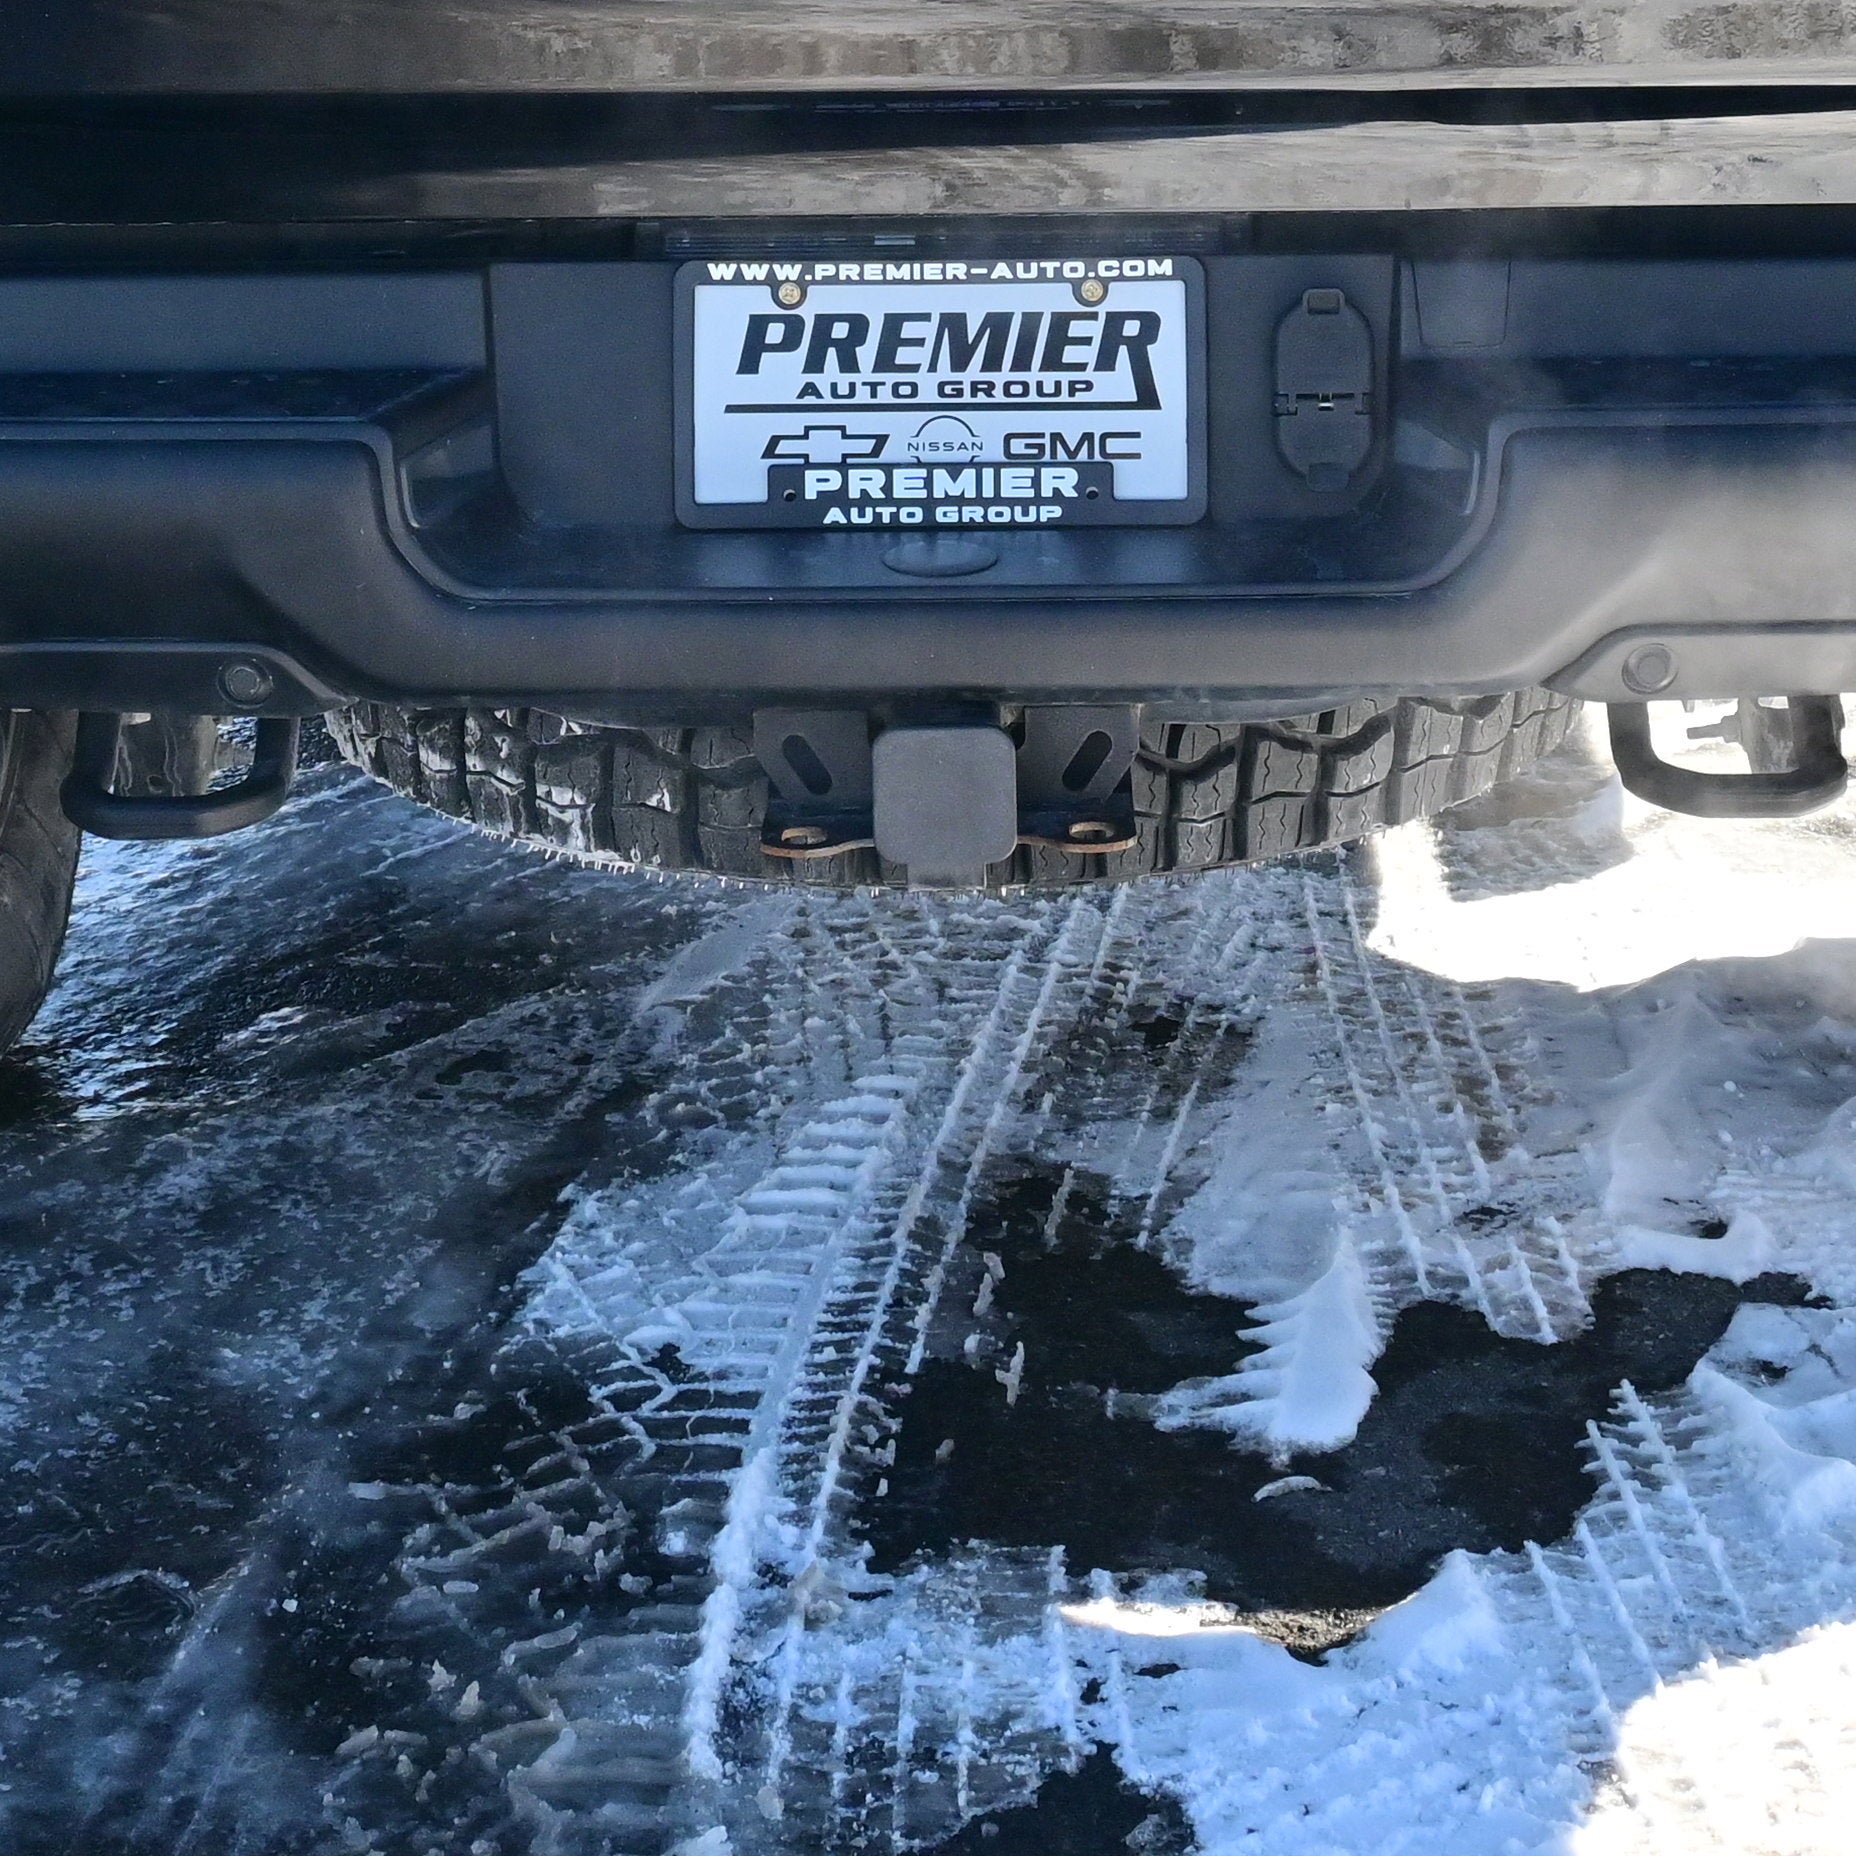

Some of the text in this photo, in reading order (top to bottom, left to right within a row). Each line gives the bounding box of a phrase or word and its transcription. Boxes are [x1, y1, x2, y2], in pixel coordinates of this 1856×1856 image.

[707, 259, 1173, 282] WWW.PREMIER-AUTO.COM
[735, 310, 1162, 376] PREMIER
[796, 379, 1094, 400] AUTO GROUP
[907, 439, 983, 453] NISSAN
[1002, 431, 1142, 461] GMC
[804, 467, 1079, 500] PREMIER
[823, 505, 1063, 525] AUTO GROUP
